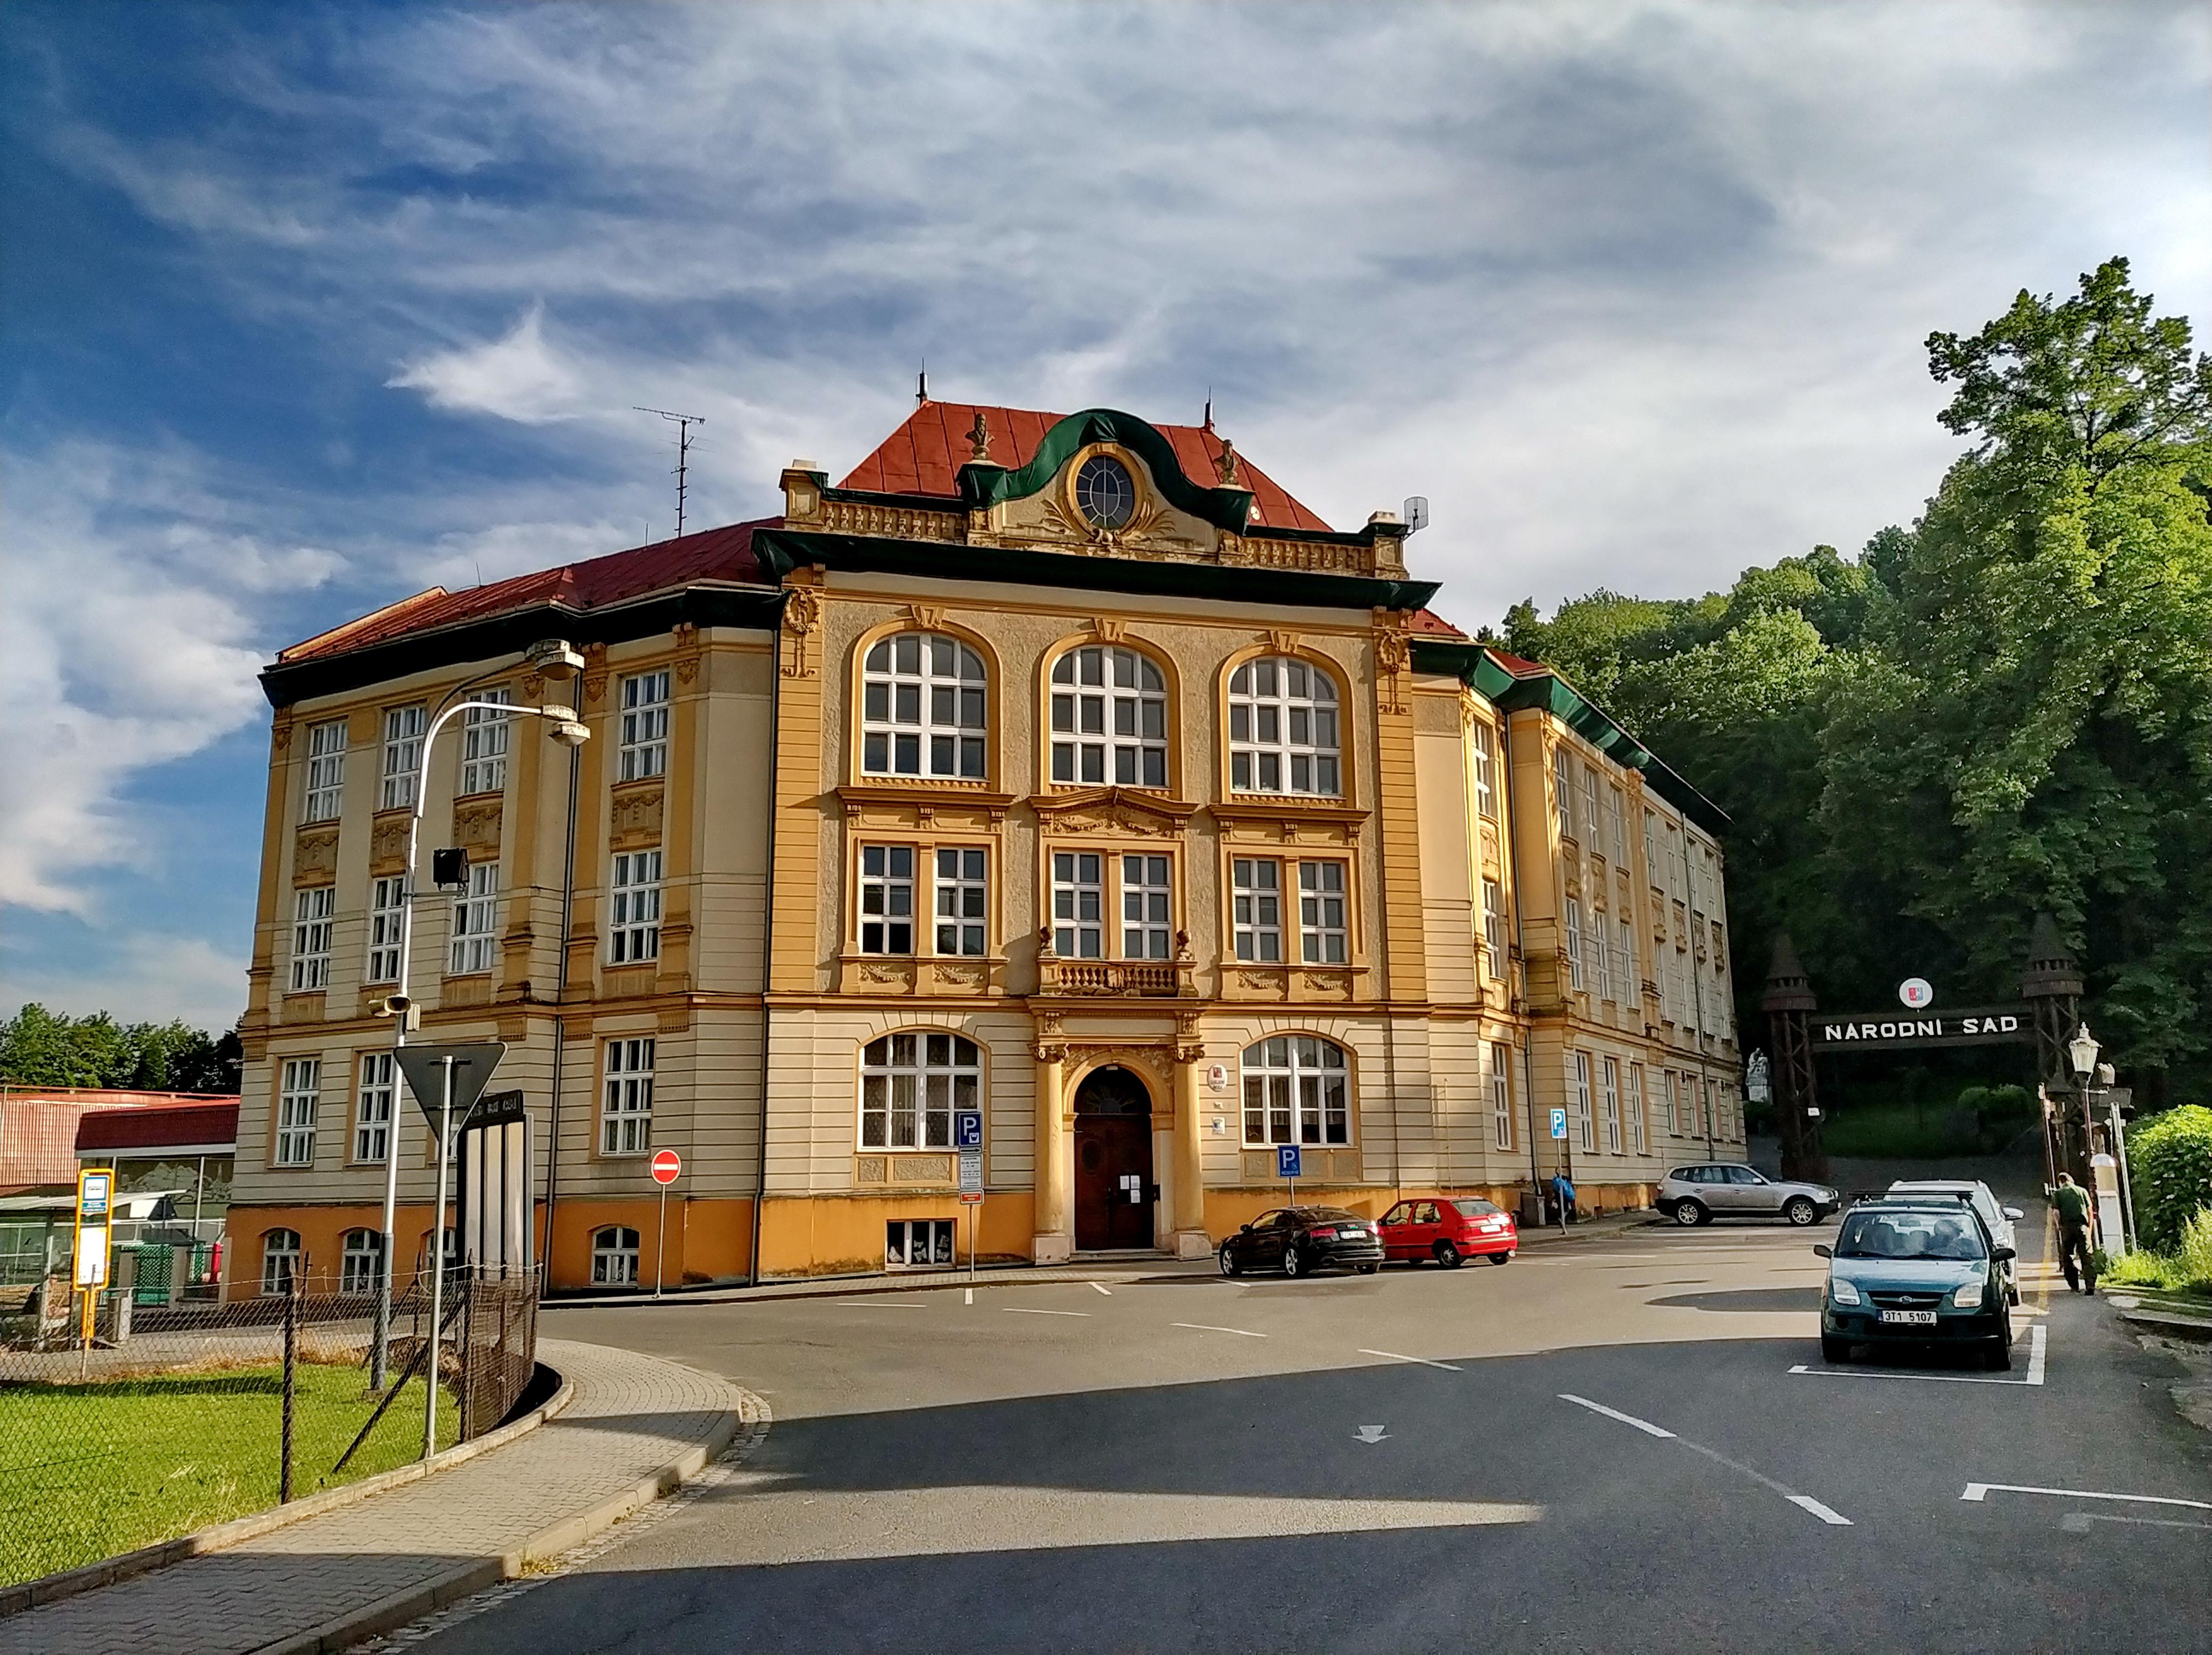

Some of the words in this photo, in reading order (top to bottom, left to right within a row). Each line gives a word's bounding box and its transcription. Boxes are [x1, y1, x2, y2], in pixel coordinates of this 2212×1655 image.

[1963, 1016, 2018, 1033] SAD
[963, 1117, 977, 1136] P
[1554, 1113, 1562, 1130] P
[1282, 1150, 1295, 1168] P
[1885, 1312, 1902, 1321] 3T1
[1909, 1313, 1932, 1322] 5107
